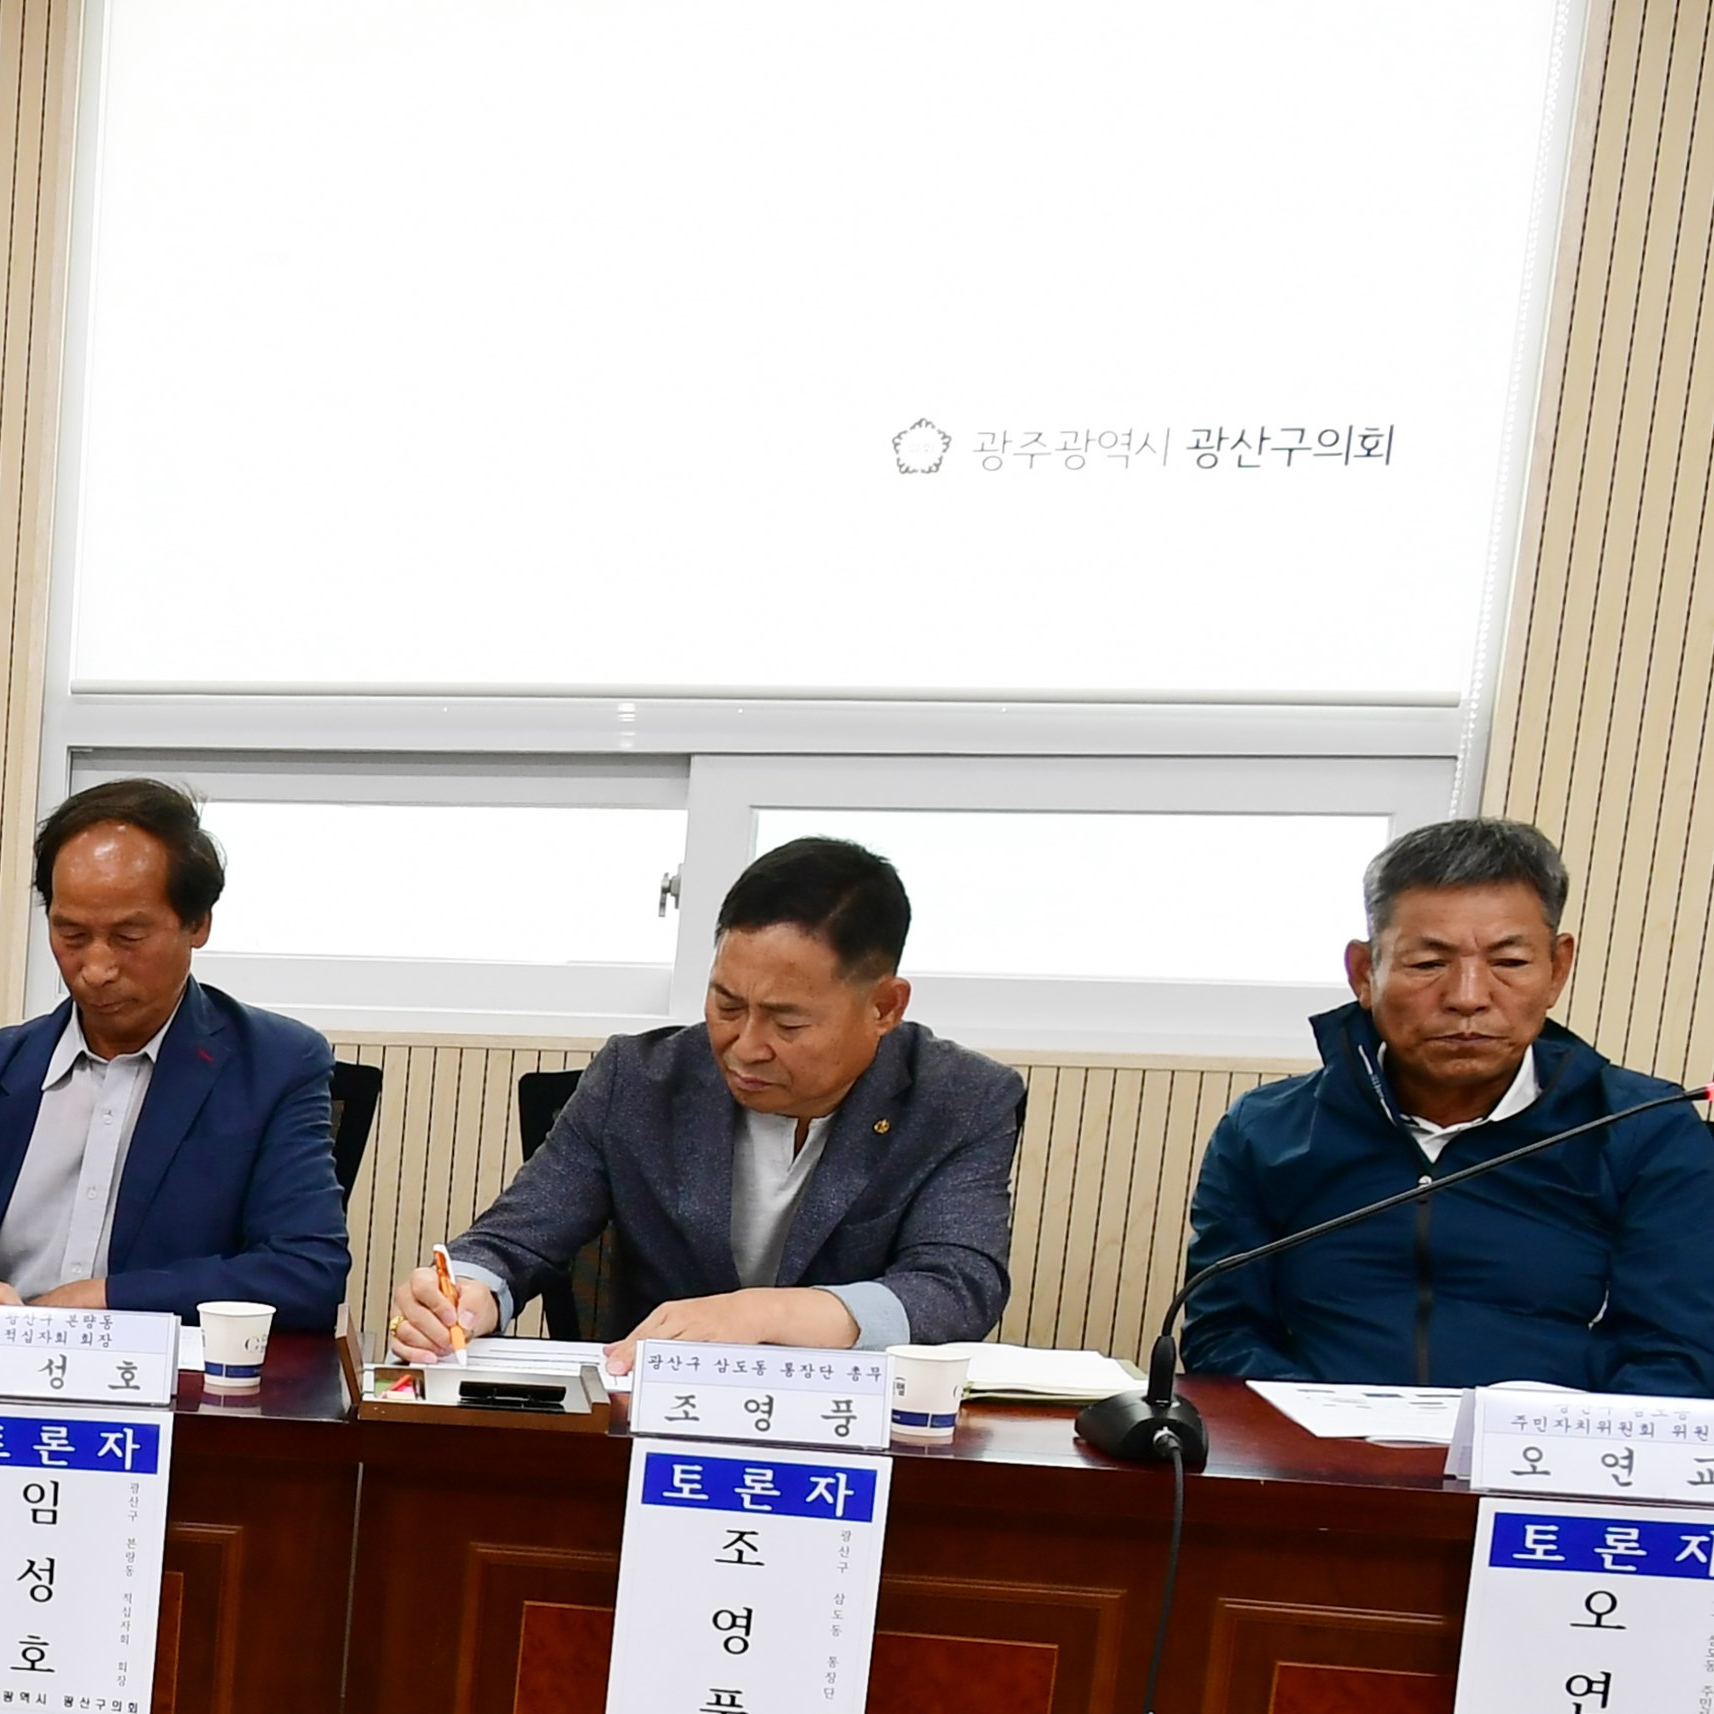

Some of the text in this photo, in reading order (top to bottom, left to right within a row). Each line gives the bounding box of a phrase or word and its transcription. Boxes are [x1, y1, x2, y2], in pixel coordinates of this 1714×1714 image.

[973, 424, 1395, 472] 광주광역시 광산구의회
[5, 1328, 113, 1349] 적십자회 회장
[648, 1354, 882, 1383] 광산구 삼도동 통장단 총무
[664, 1394, 857, 1438] 조영풍
[1510, 1414, 1656, 1438] 주민자치위원회
[1510, 1446, 1714, 1487] 오연교
[662, 1463, 855, 1518] 토론자
[10, 1480, 59, 1673] 임성호
[63, 1695, 138, 1714] 광산구의회
